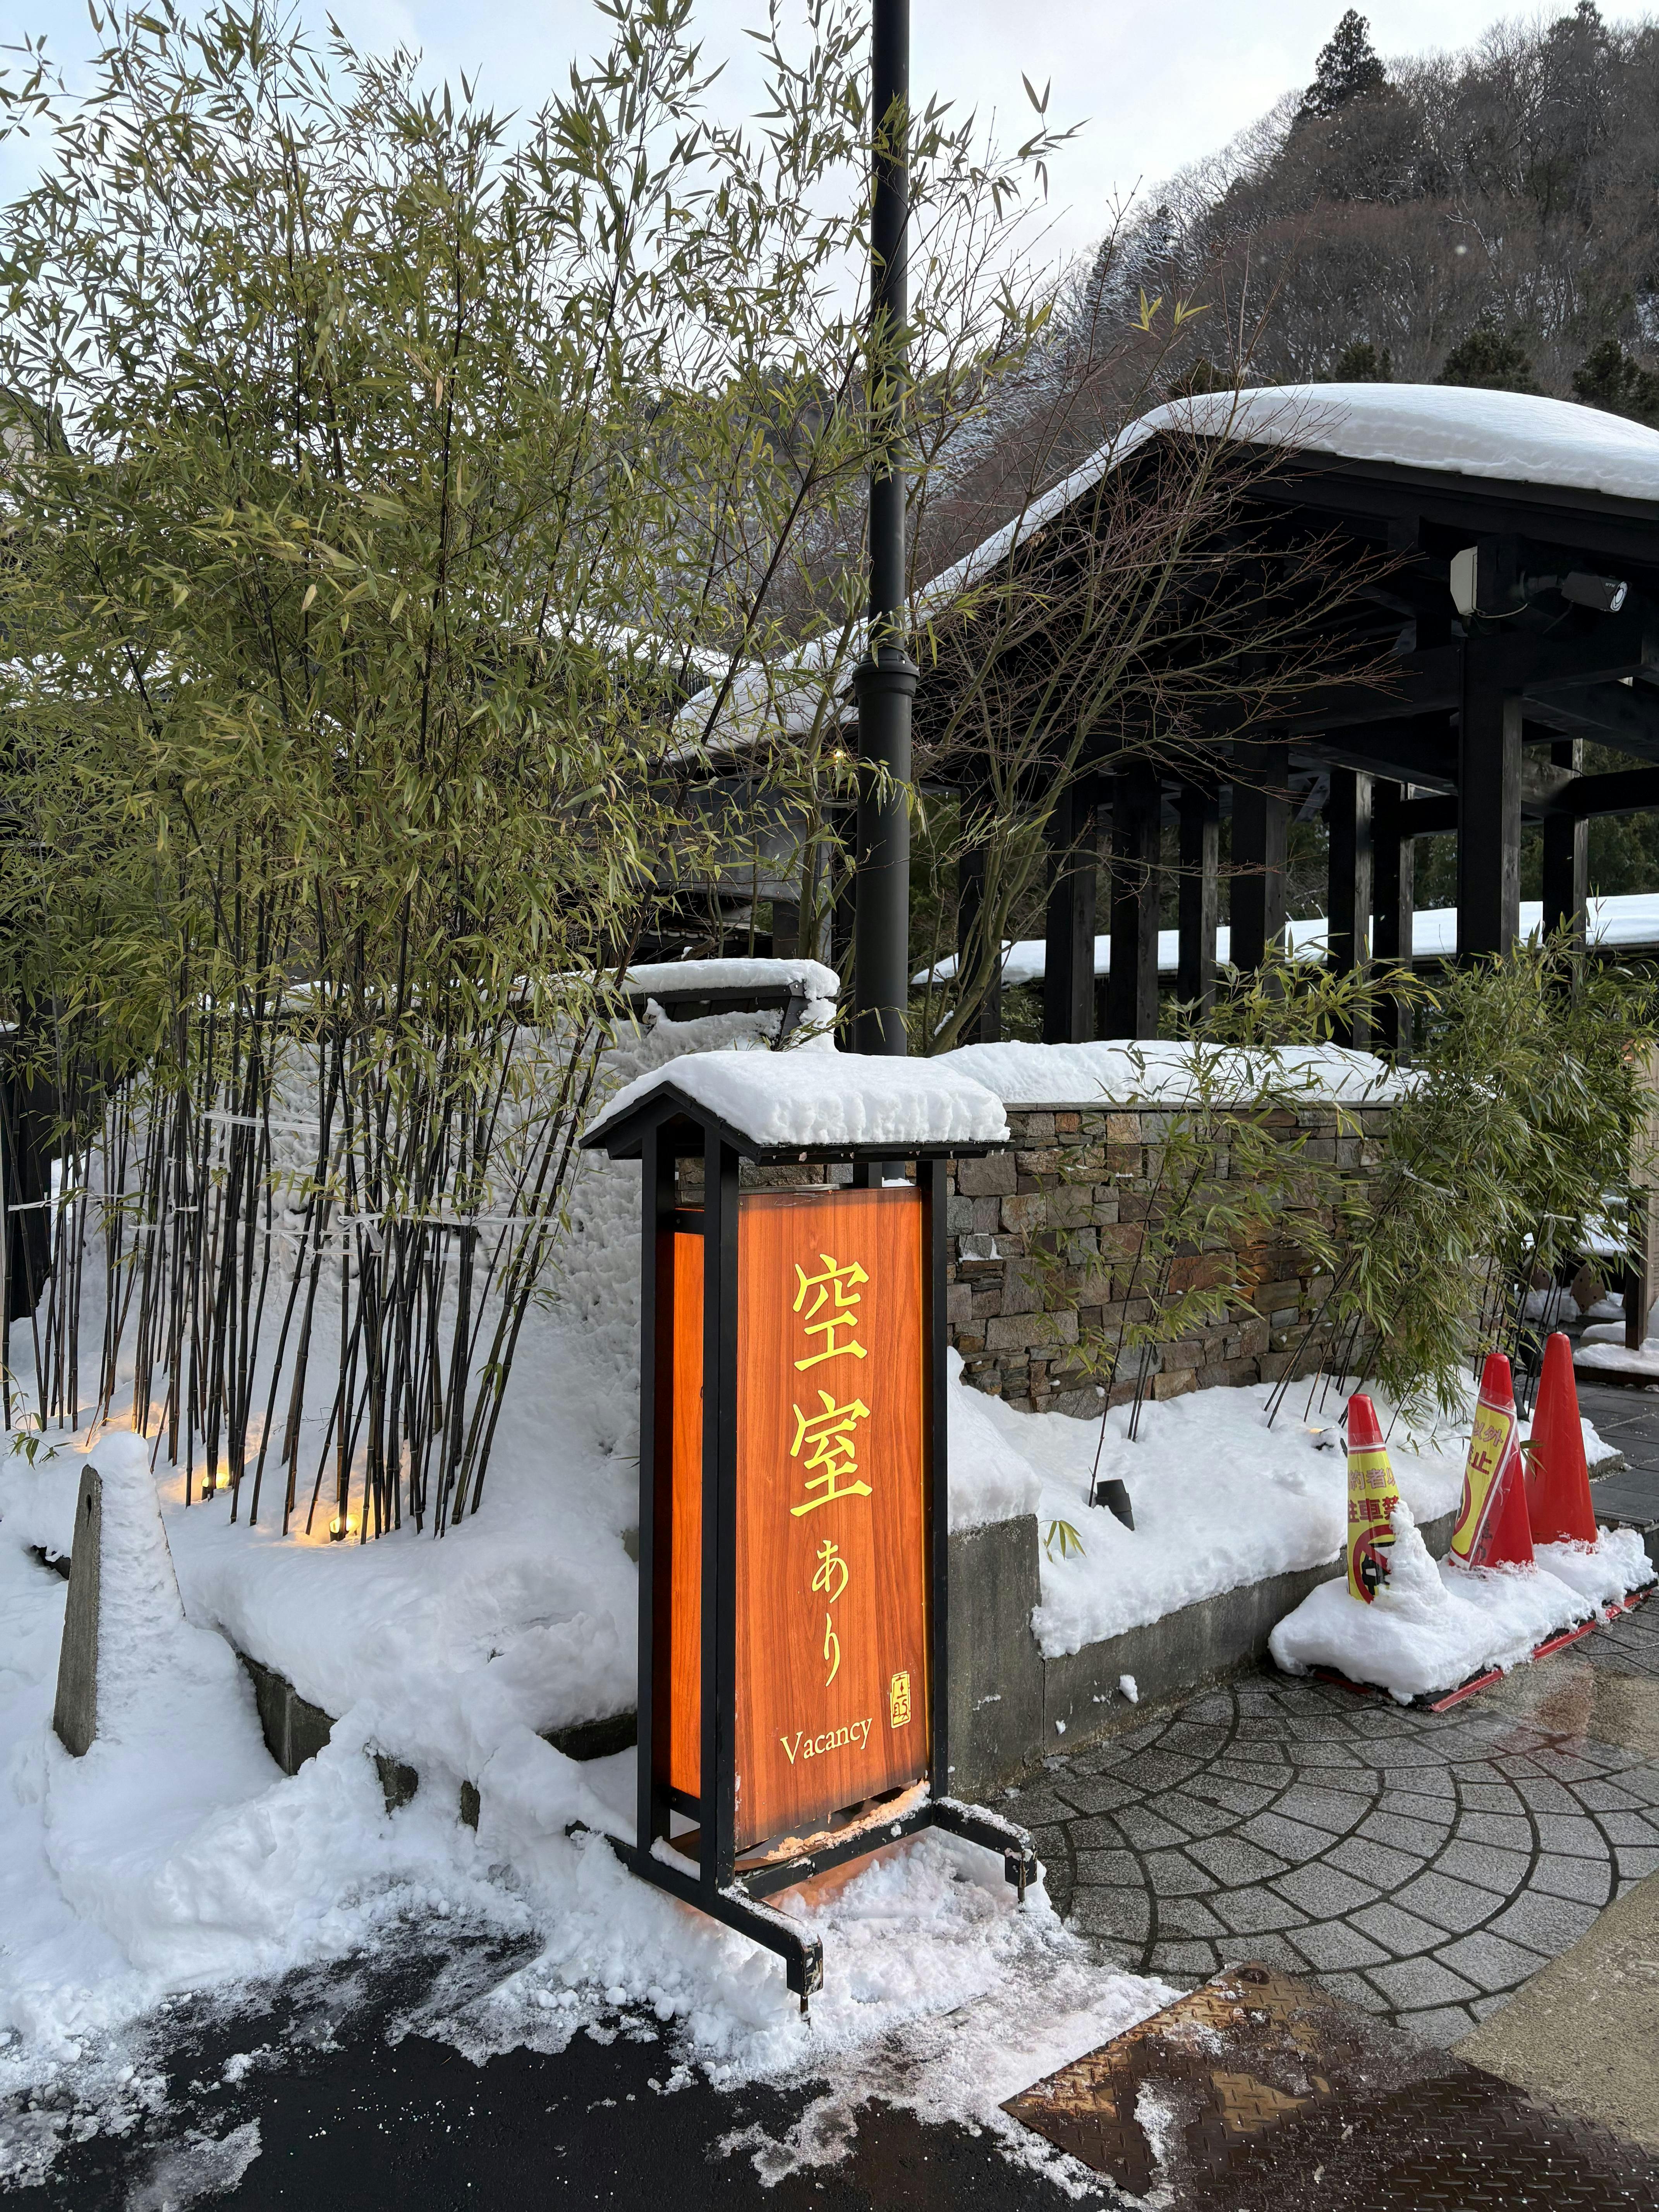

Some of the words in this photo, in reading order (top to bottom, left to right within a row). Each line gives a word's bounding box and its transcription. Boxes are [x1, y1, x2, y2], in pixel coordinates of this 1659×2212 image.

[790, 1254, 872, 1687] 空室あり
[780, 1717, 873, 1764] Vacancy
